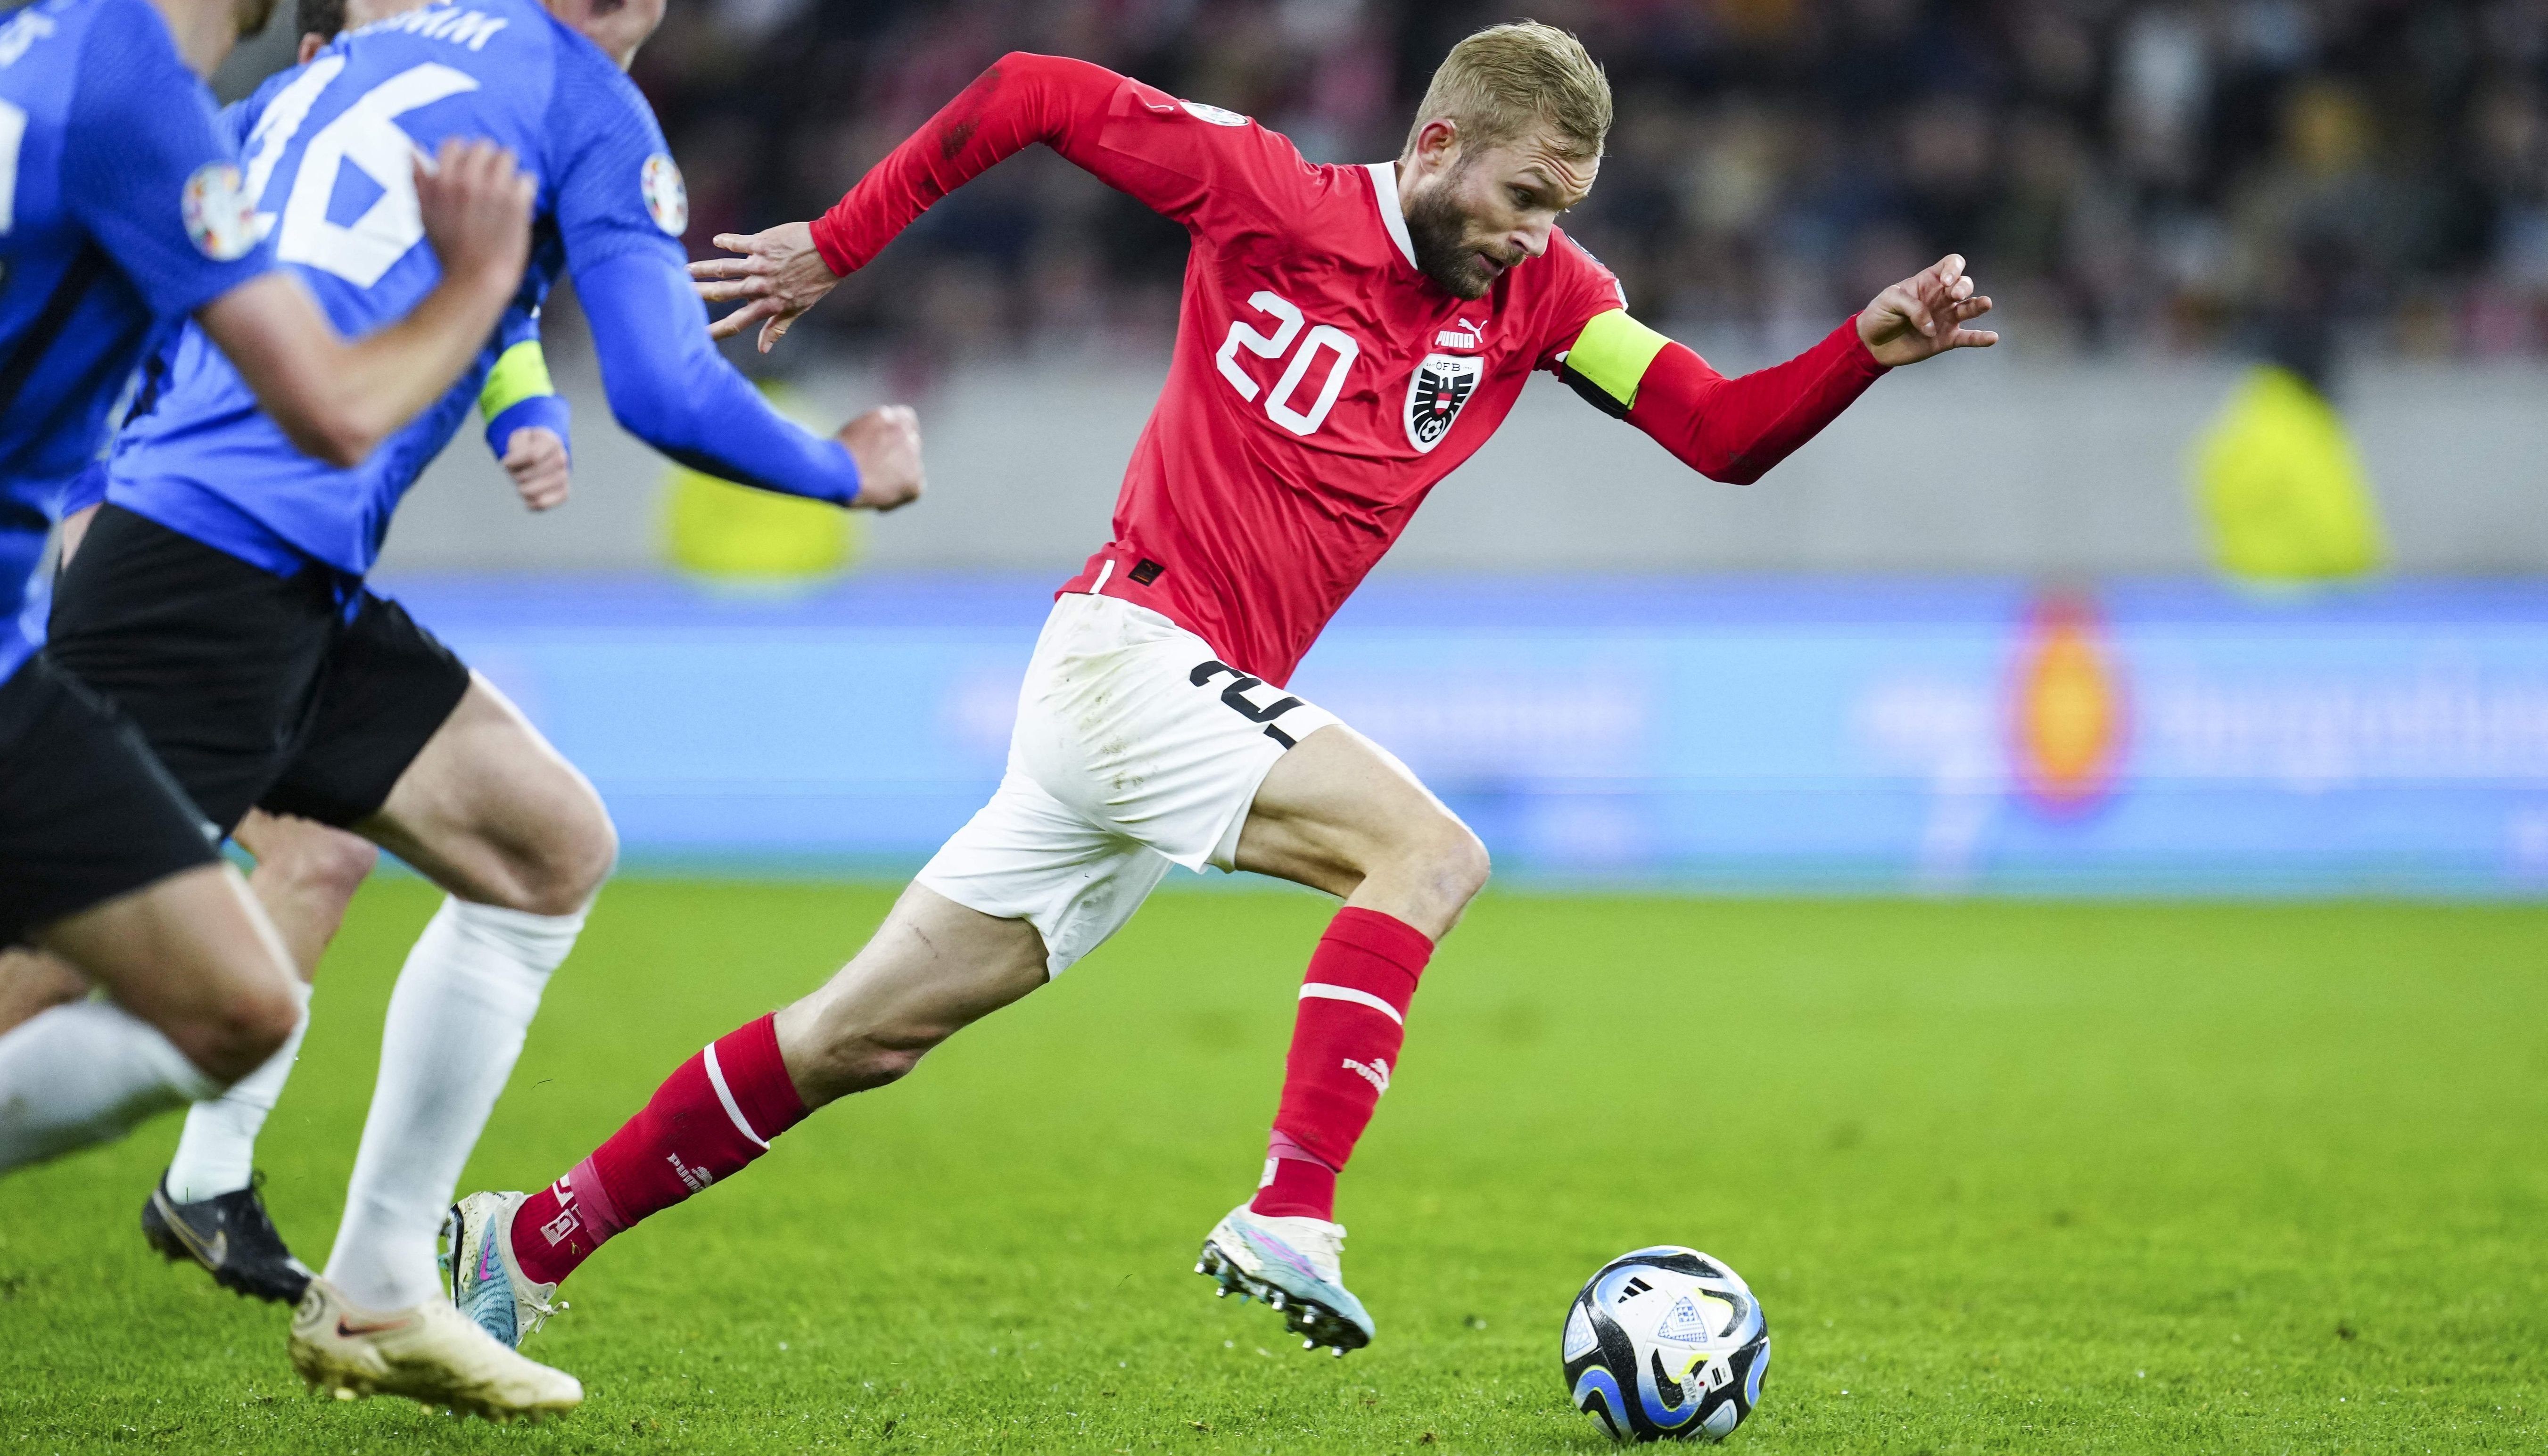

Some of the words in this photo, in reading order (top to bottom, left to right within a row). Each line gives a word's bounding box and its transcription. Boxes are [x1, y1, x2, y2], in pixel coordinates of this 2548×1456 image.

[239, 55, 480, 289] 16
[1215, 290, 1360, 436] 20
[1435, 330, 1474, 349] PUMA
[1436, 360, 1460, 371] ÖFB
[1189, 660, 1307, 750] 2
